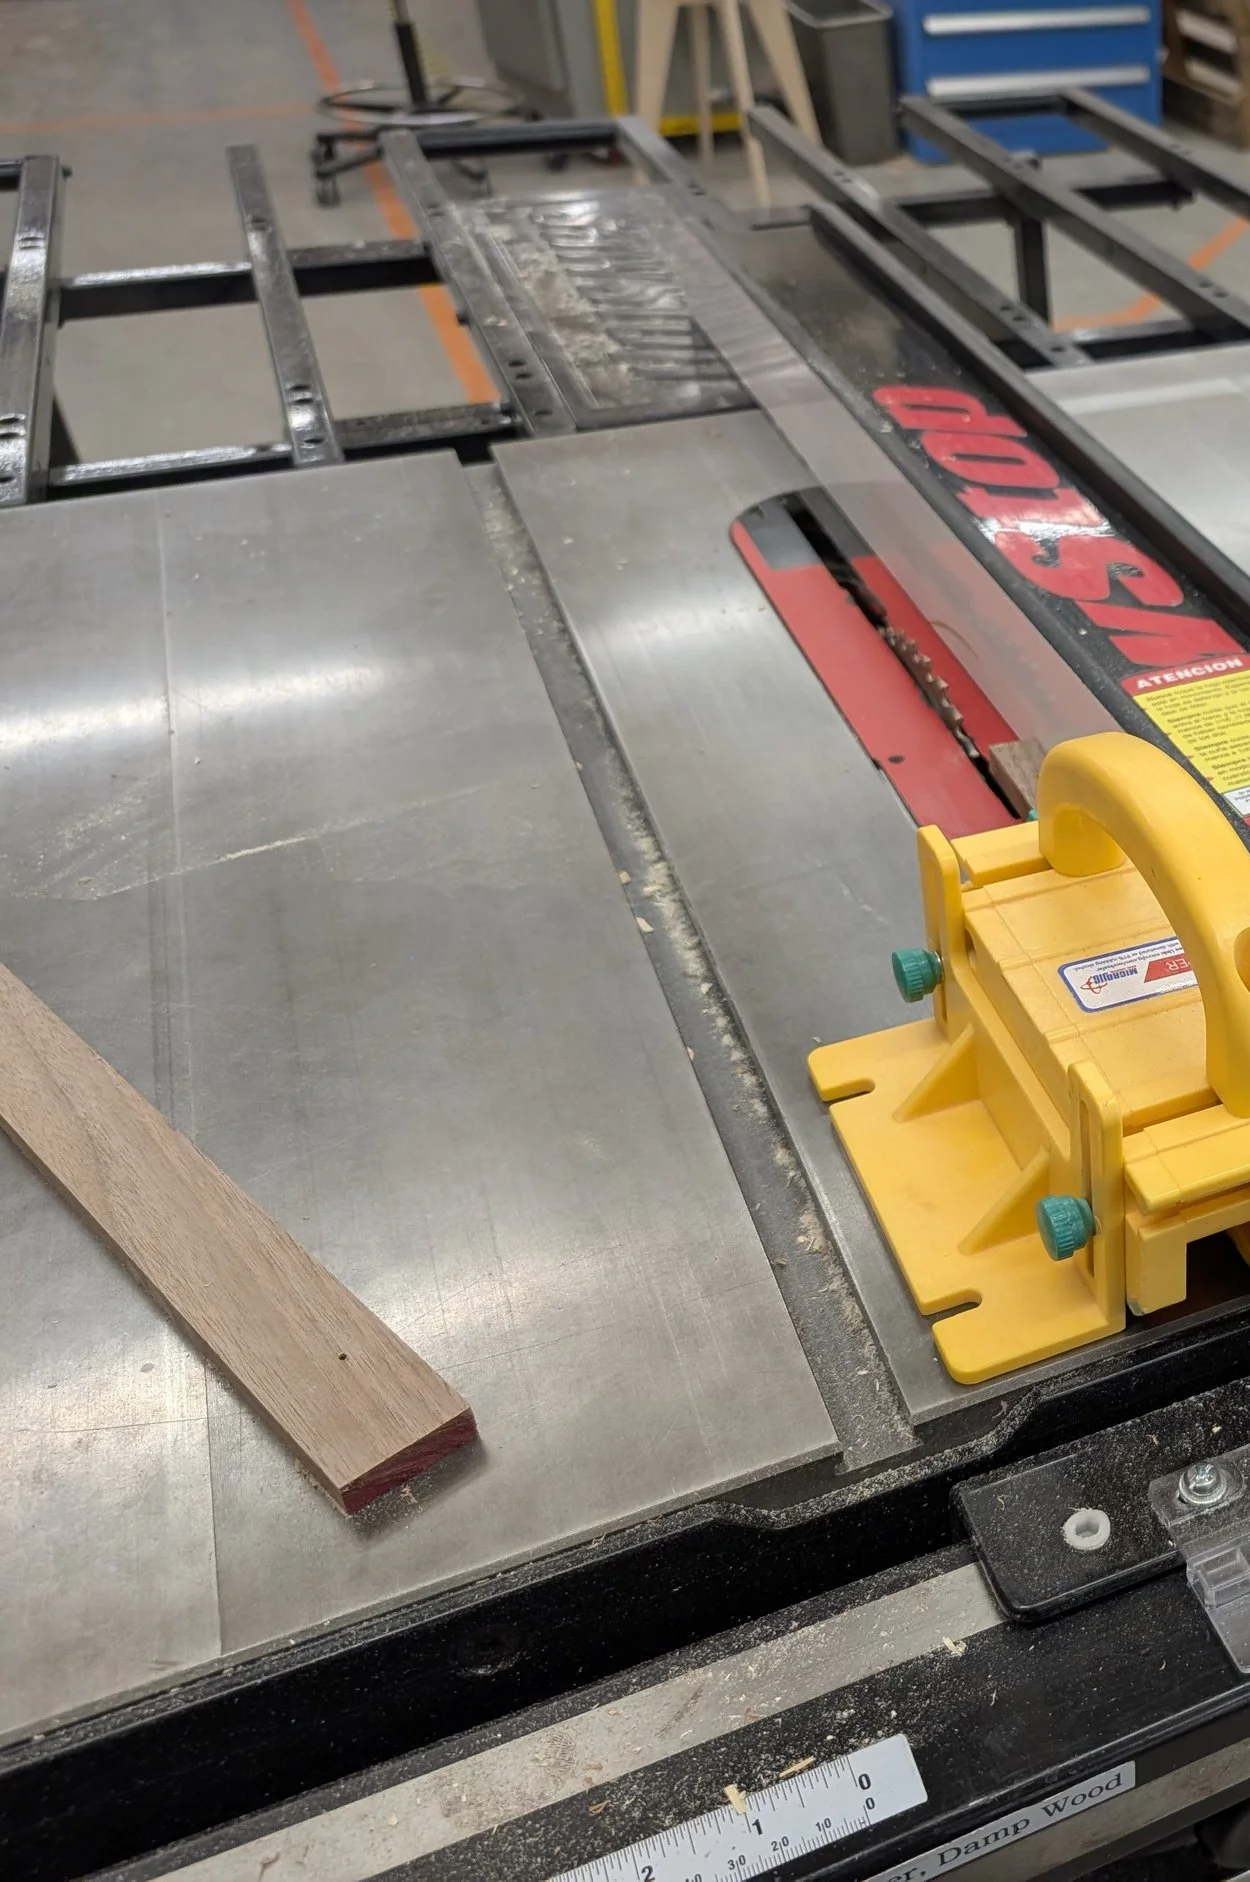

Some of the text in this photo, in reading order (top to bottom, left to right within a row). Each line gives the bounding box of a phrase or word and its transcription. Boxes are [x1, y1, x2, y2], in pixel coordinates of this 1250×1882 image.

[1136, 658, 1244, 690] ATENCION
[641, 1773, 872, 1882] 2 1 0
[727, 1854, 747, 1871] 30
[770, 1836, 790, 1852] 20
[815, 1817, 832, 1832] 10
[865, 1796, 876, 1810] 0
[938, 1817, 1030, 1867] Damp
[1041, 1772, 1123, 1818] Wood
